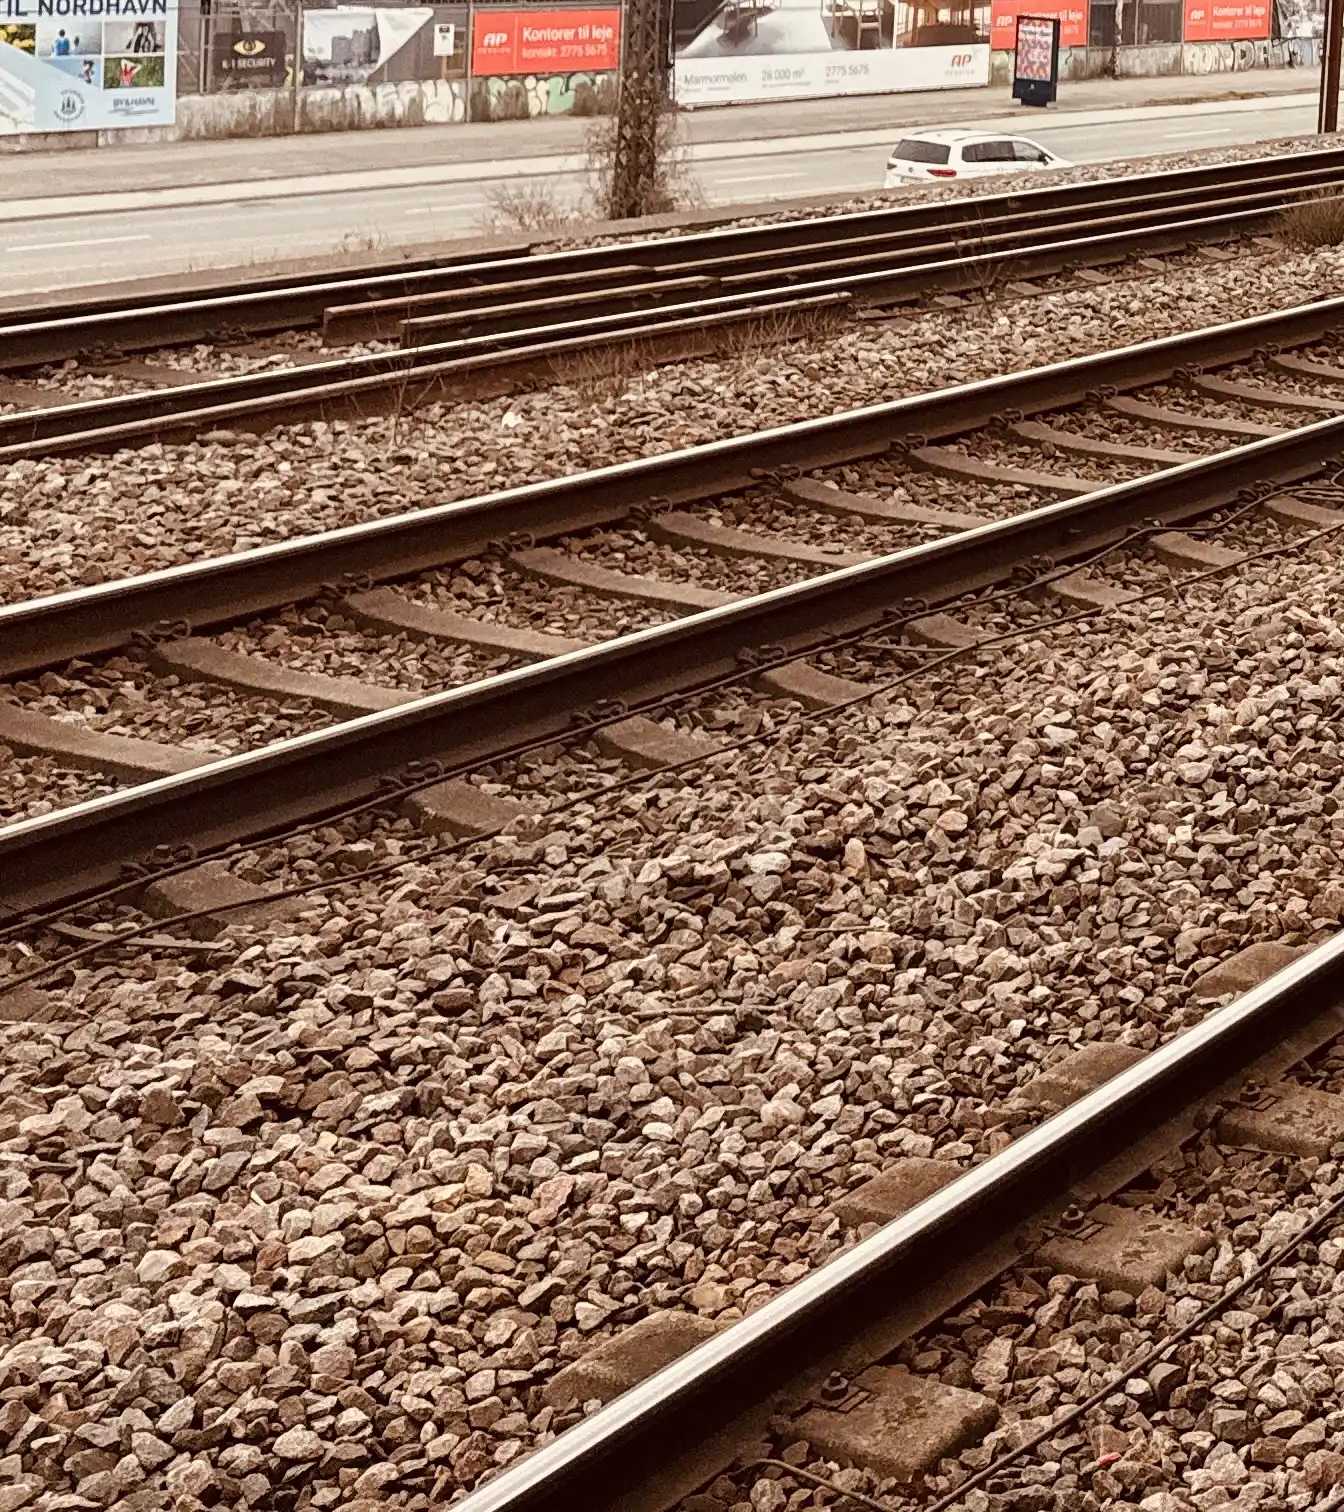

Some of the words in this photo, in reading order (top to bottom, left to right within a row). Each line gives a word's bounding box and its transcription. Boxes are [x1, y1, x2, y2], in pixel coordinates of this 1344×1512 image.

[483, 32, 508, 47] AP
[523, 26, 576, 42] Kontorer
[578, 24, 589, 40] til
[591, 23, 613, 43] leje
[951, 54, 972, 68] AP
[825, 65, 847, 78] 2775
